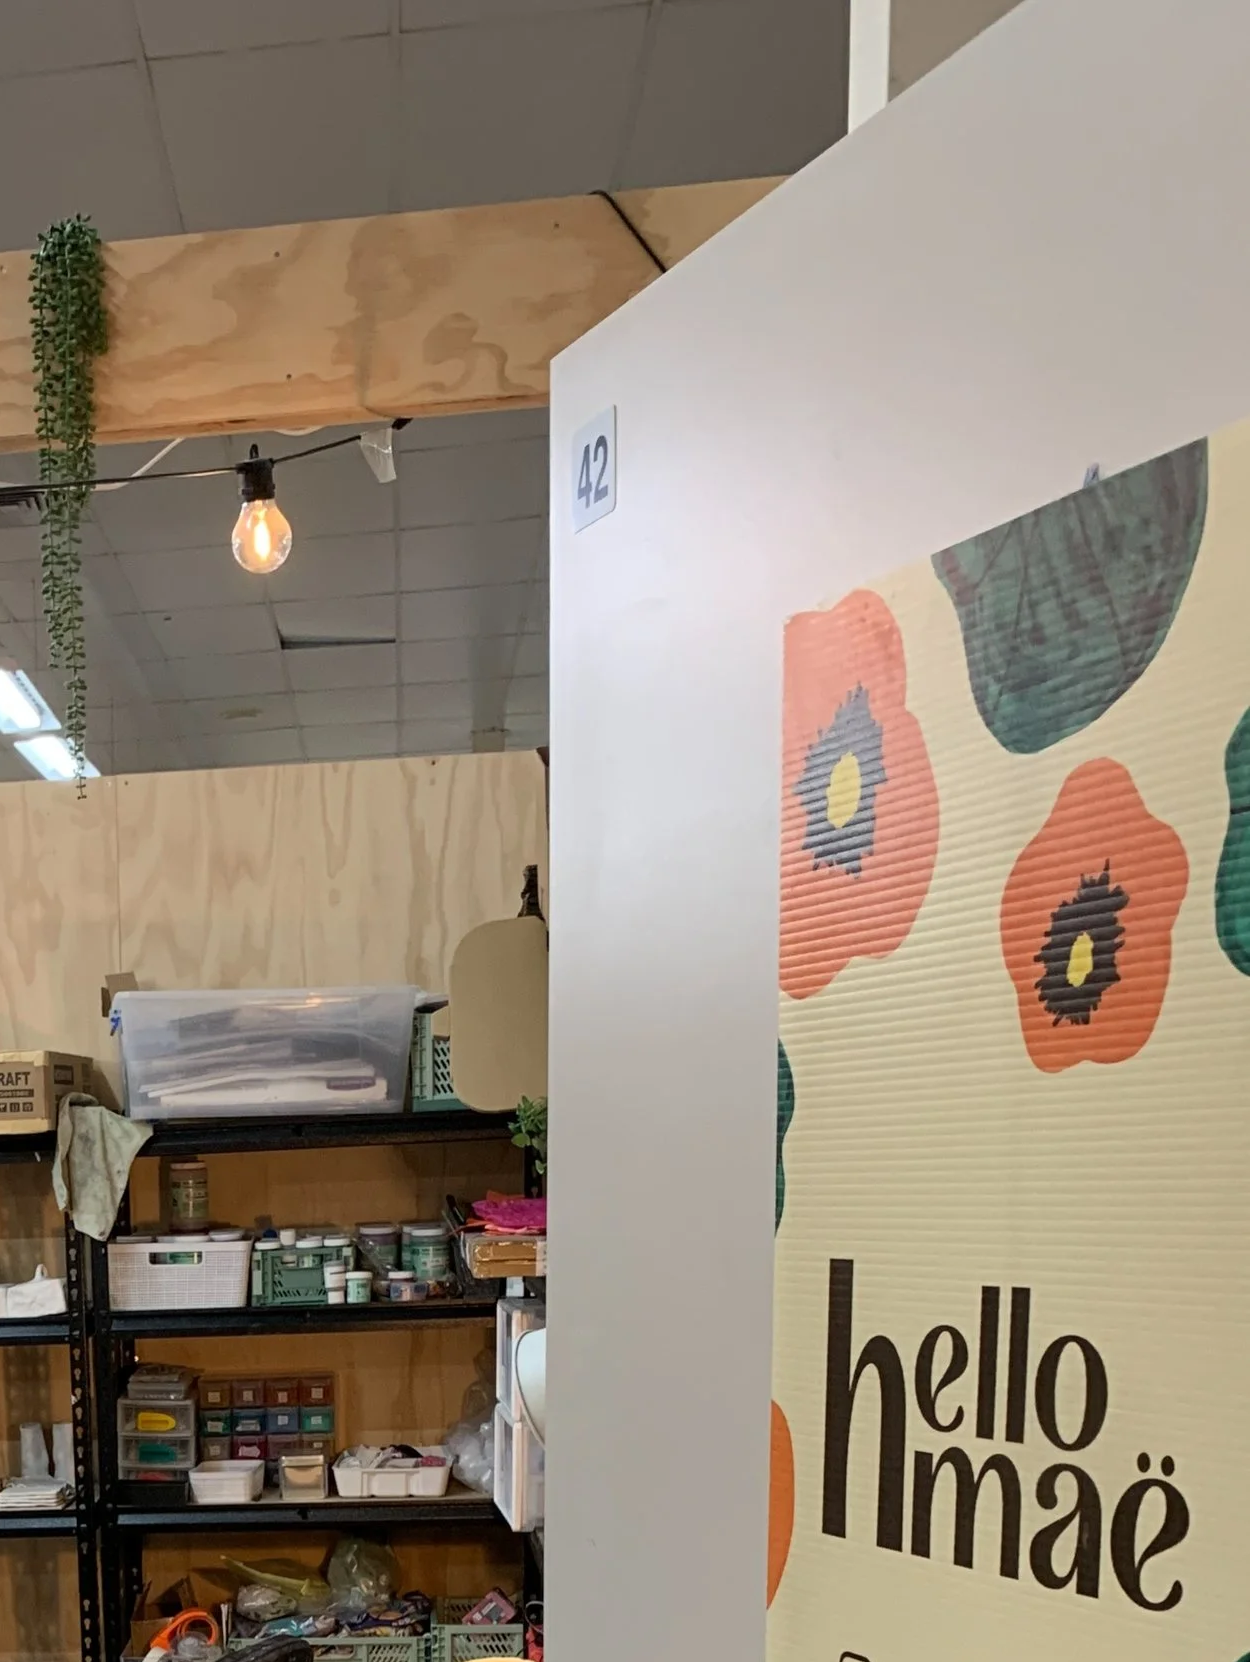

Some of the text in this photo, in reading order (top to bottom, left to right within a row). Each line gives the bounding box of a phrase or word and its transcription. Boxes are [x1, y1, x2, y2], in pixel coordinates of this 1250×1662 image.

[577, 435, 609, 509] 42
[822, 1258, 1109, 1554] hello
[911, 1452, 1191, 1613] maë
